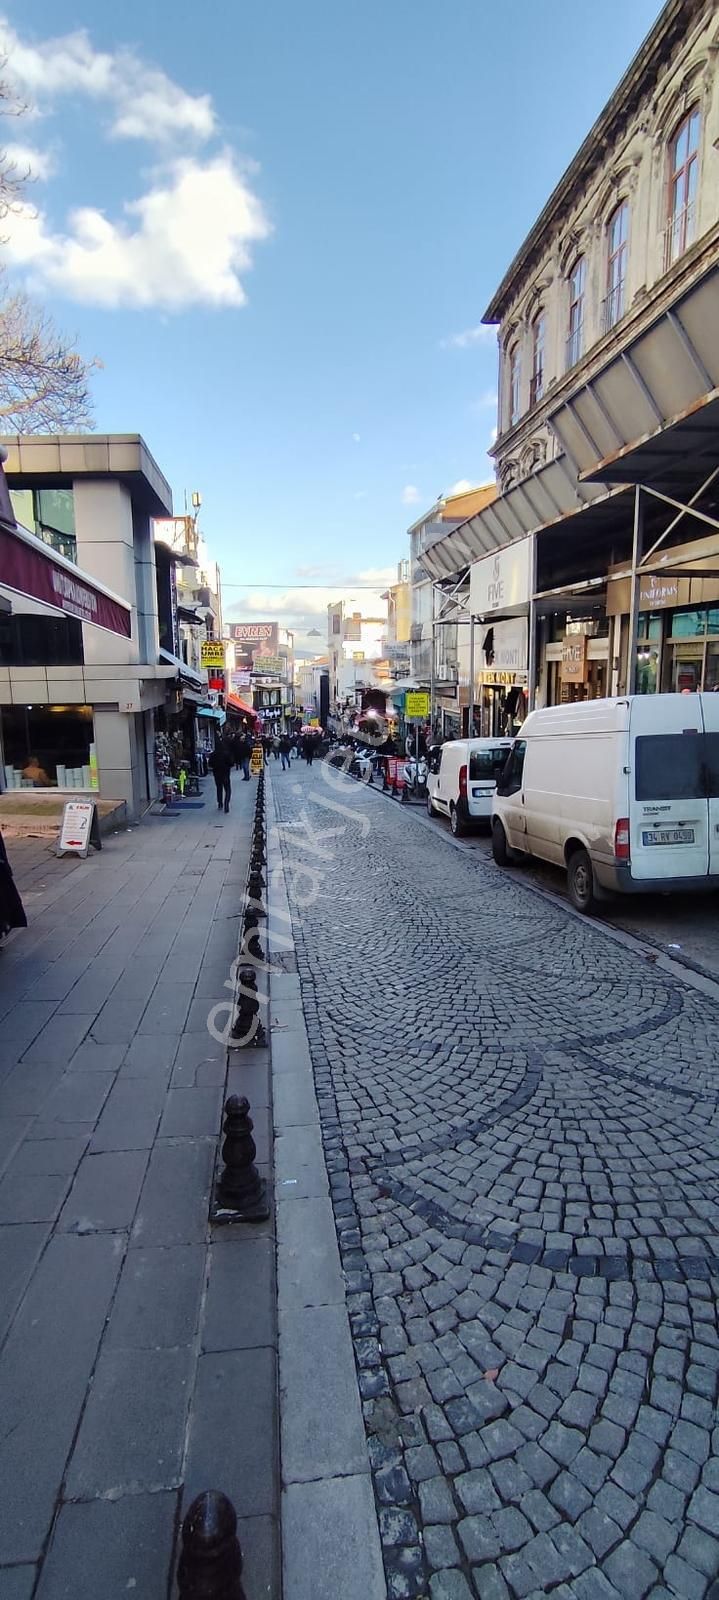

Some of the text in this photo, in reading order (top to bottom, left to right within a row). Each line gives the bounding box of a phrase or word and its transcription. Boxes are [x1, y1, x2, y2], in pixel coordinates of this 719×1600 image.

[488, 581, 504, 601] FIVE
[235, 626, 272, 637] EVREN
[562, 645, 580, 661] FIVE
